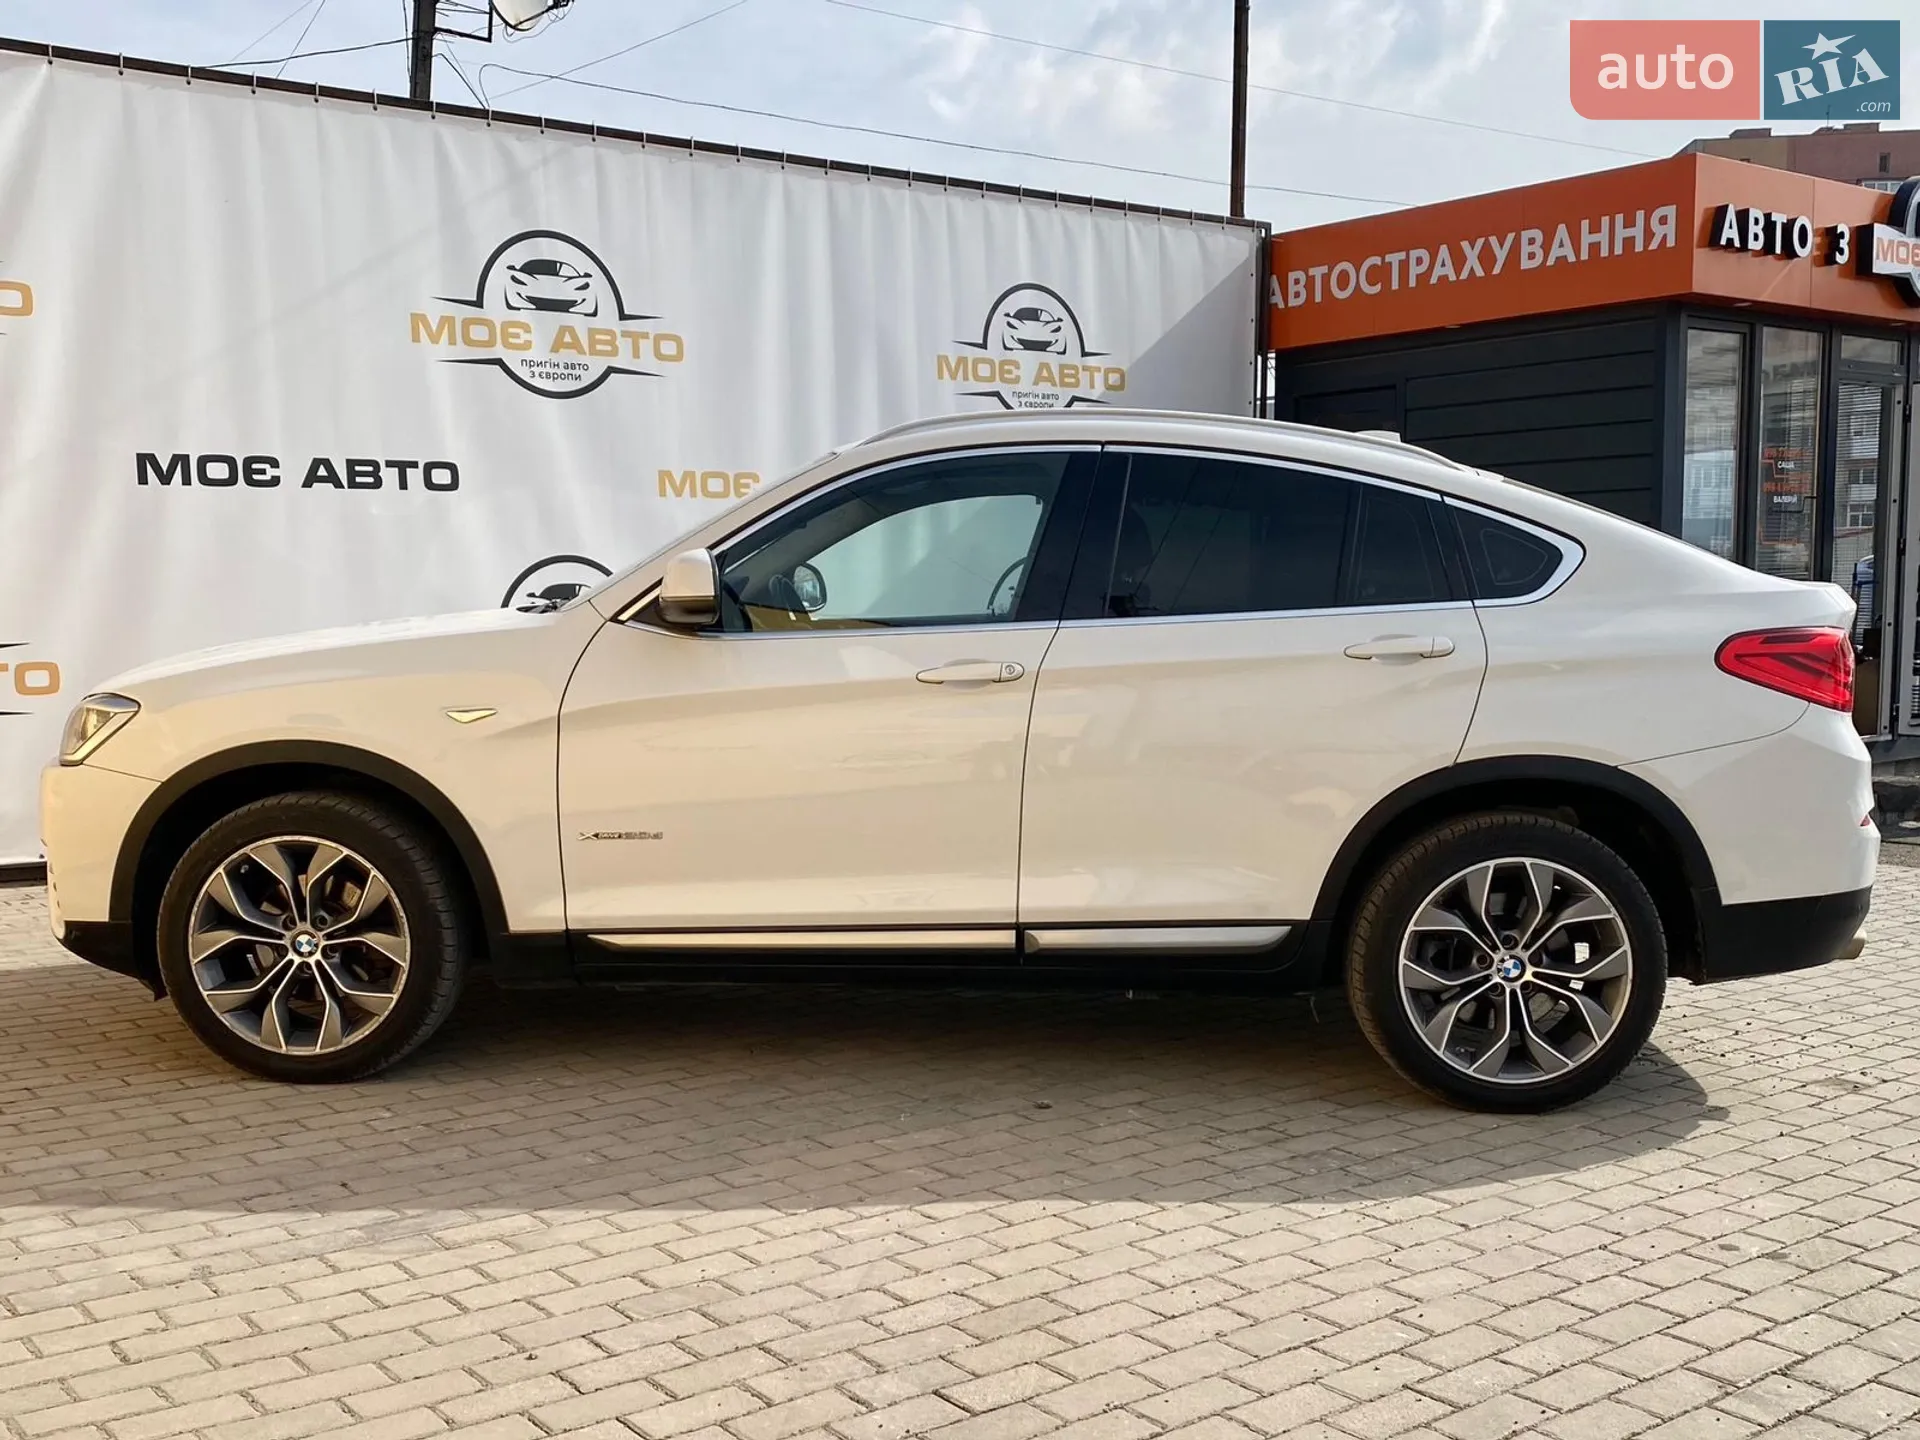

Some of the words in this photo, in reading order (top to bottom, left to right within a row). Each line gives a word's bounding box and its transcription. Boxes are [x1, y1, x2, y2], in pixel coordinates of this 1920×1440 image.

[1719, 203, 1814, 258] АВТО
[1268, 195, 1677, 309] АВТОСТРАХУВАННЯ
[410, 313, 533, 352] МОЄ
[549, 325, 684, 362] АВТО
[520, 358, 560, 374] пригін
[563, 361, 590, 372] авто
[538, 371, 582, 382] європи
[937, 354, 1021, 385] МОЄ
[1032, 362, 1126, 391] АВТО
[136, 452, 281, 488] МОЄ
[301, 457, 460, 492] АВТО
[658, 470, 760, 499] МОЄ
